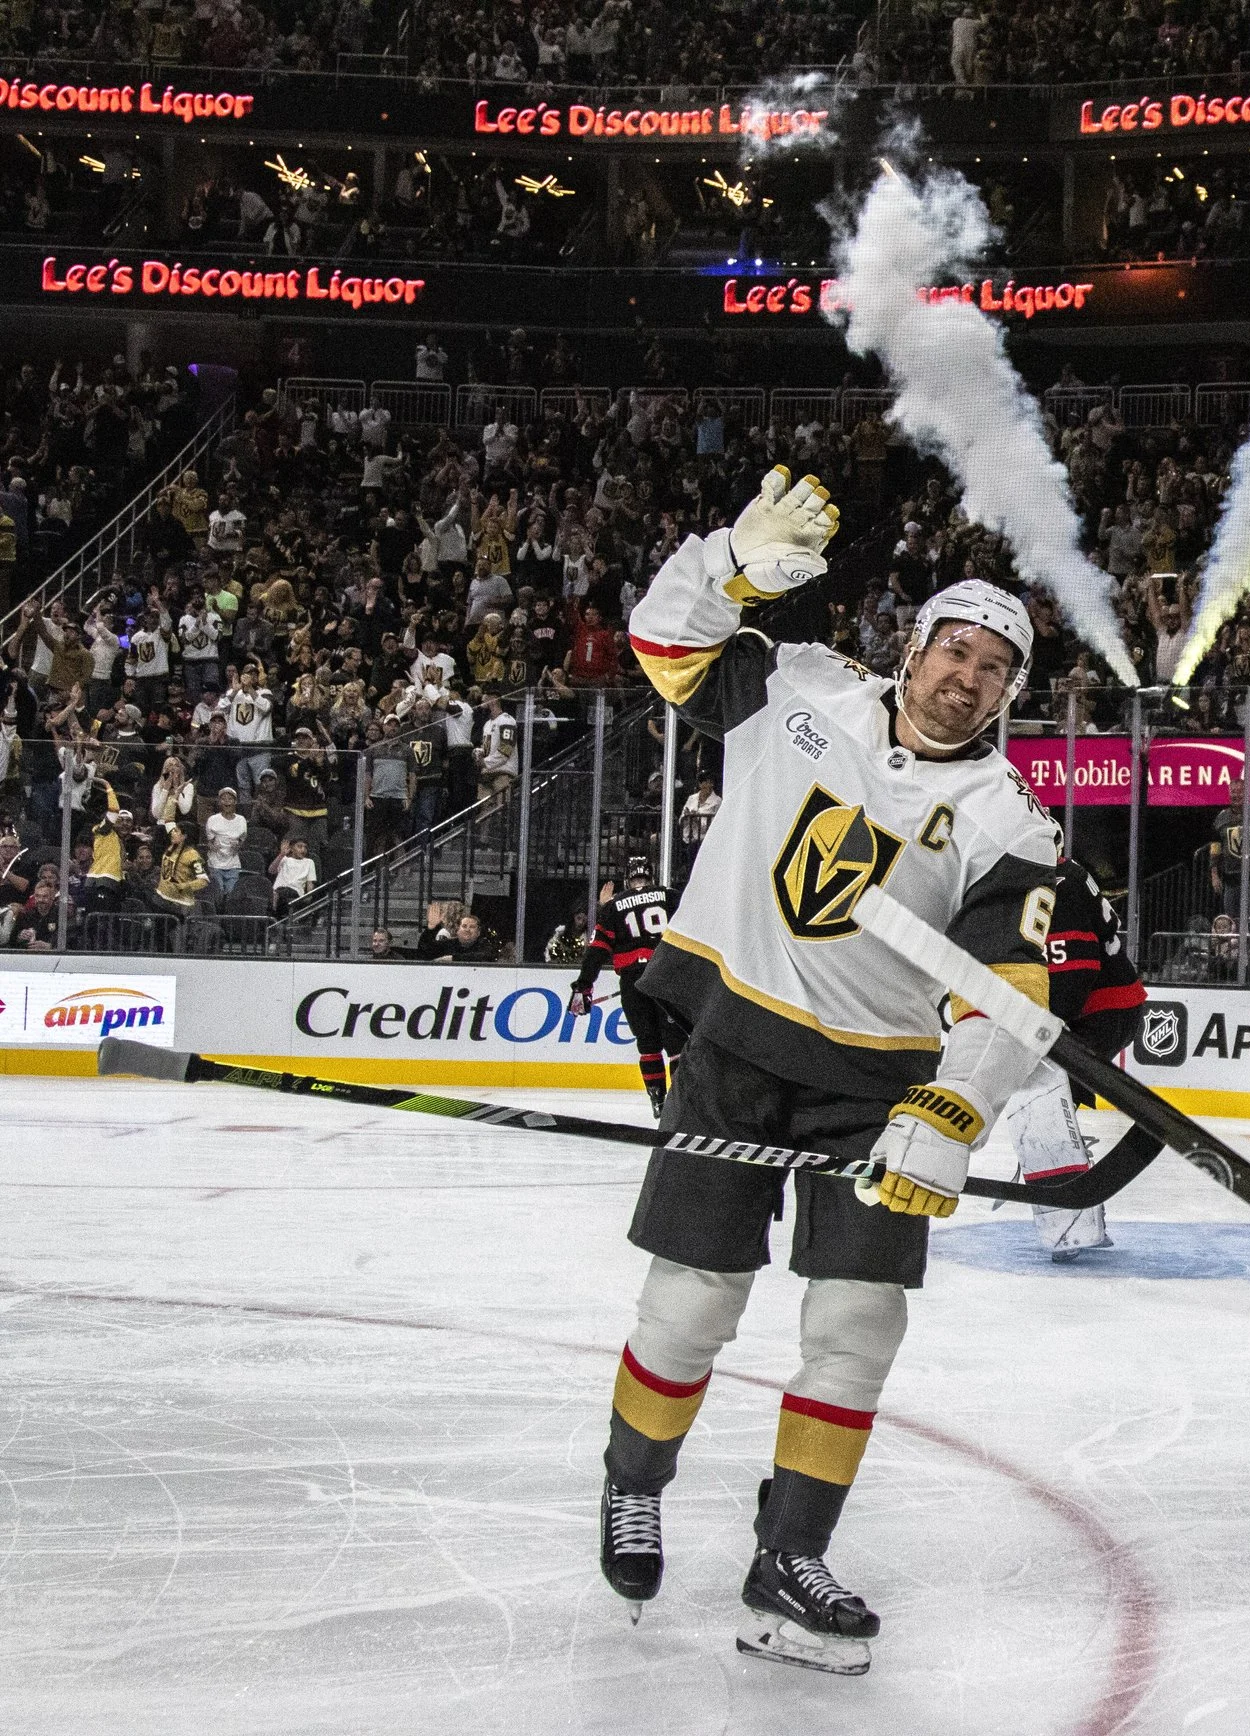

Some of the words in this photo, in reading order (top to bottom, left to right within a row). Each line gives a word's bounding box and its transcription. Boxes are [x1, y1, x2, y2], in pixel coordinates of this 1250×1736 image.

[140, 83, 253, 123] Liquor
[475, 101, 560, 135] Lee's
[569, 105, 713, 136] Discount
[719, 104, 828, 141] Liquor
[1080, 97, 1162, 134] Lee's
[42, 257, 133, 294] Lee's
[142, 262, 299, 298] Discount
[306, 267, 424, 309] Liquor
[724, 279, 812, 313] Lee's
[980, 279, 1093, 319] Liquor
[786, 711, 829, 749] Circa
[792, 734, 822, 760] SPORTS
[917, 802, 954, 853] C
[615, 891, 666, 912] BATHERSON
[625, 906, 668, 938] 19
[44, 1003, 164, 1037] ampm
[1150, 1022, 1172, 1046] NHL
[1061, 1098, 1081, 1151] BAUER
[777, 1589, 806, 1614] BAUER
